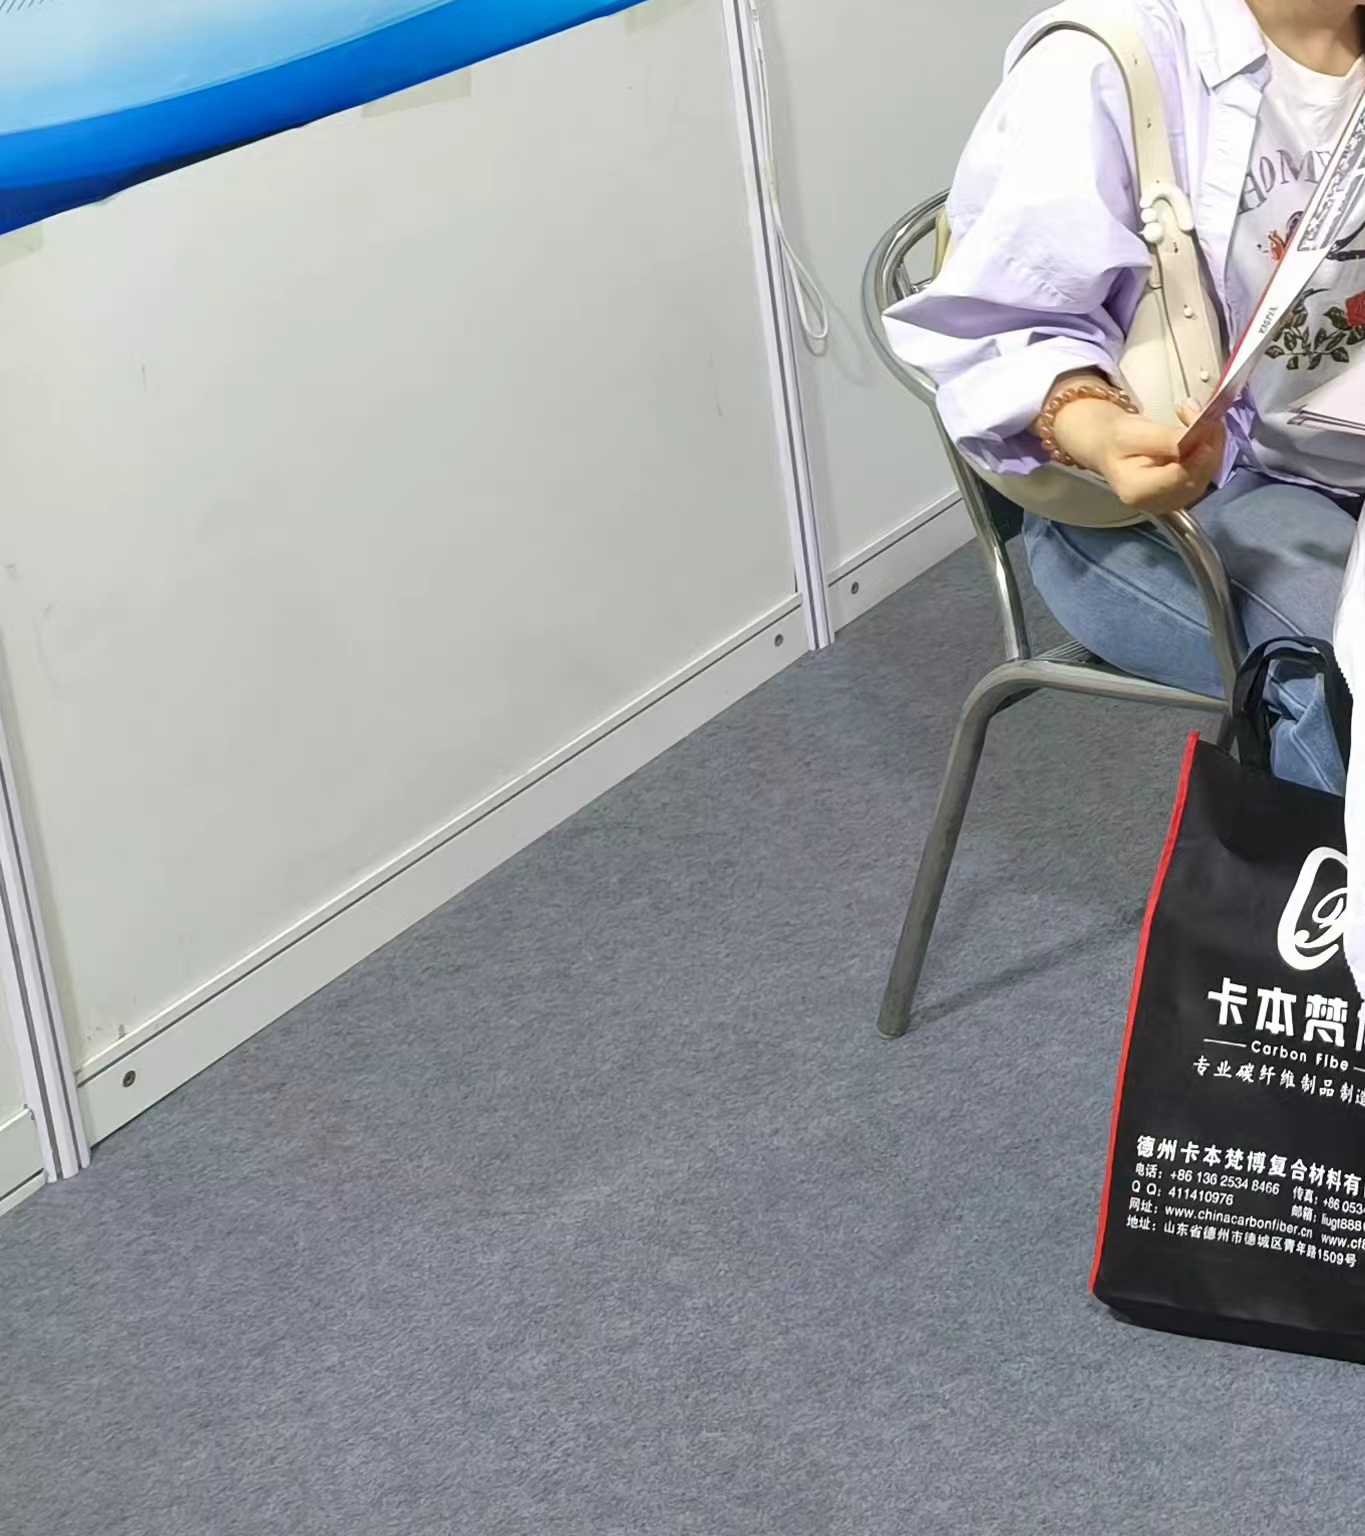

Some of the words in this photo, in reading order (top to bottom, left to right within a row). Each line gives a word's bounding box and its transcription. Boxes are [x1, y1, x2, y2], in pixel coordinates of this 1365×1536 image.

[1251, 1040, 1307, 1063] Carbon
[1170, 1170, 1192, 1183] +86
[1220, 1175, 1249, 1190] 2534
[1251, 1179, 1280, 1195] 8466
[1168, 1185, 1234, 1206] 411410976
[1165, 1204, 1313, 1239] www.chinacarbonfiber.cn
